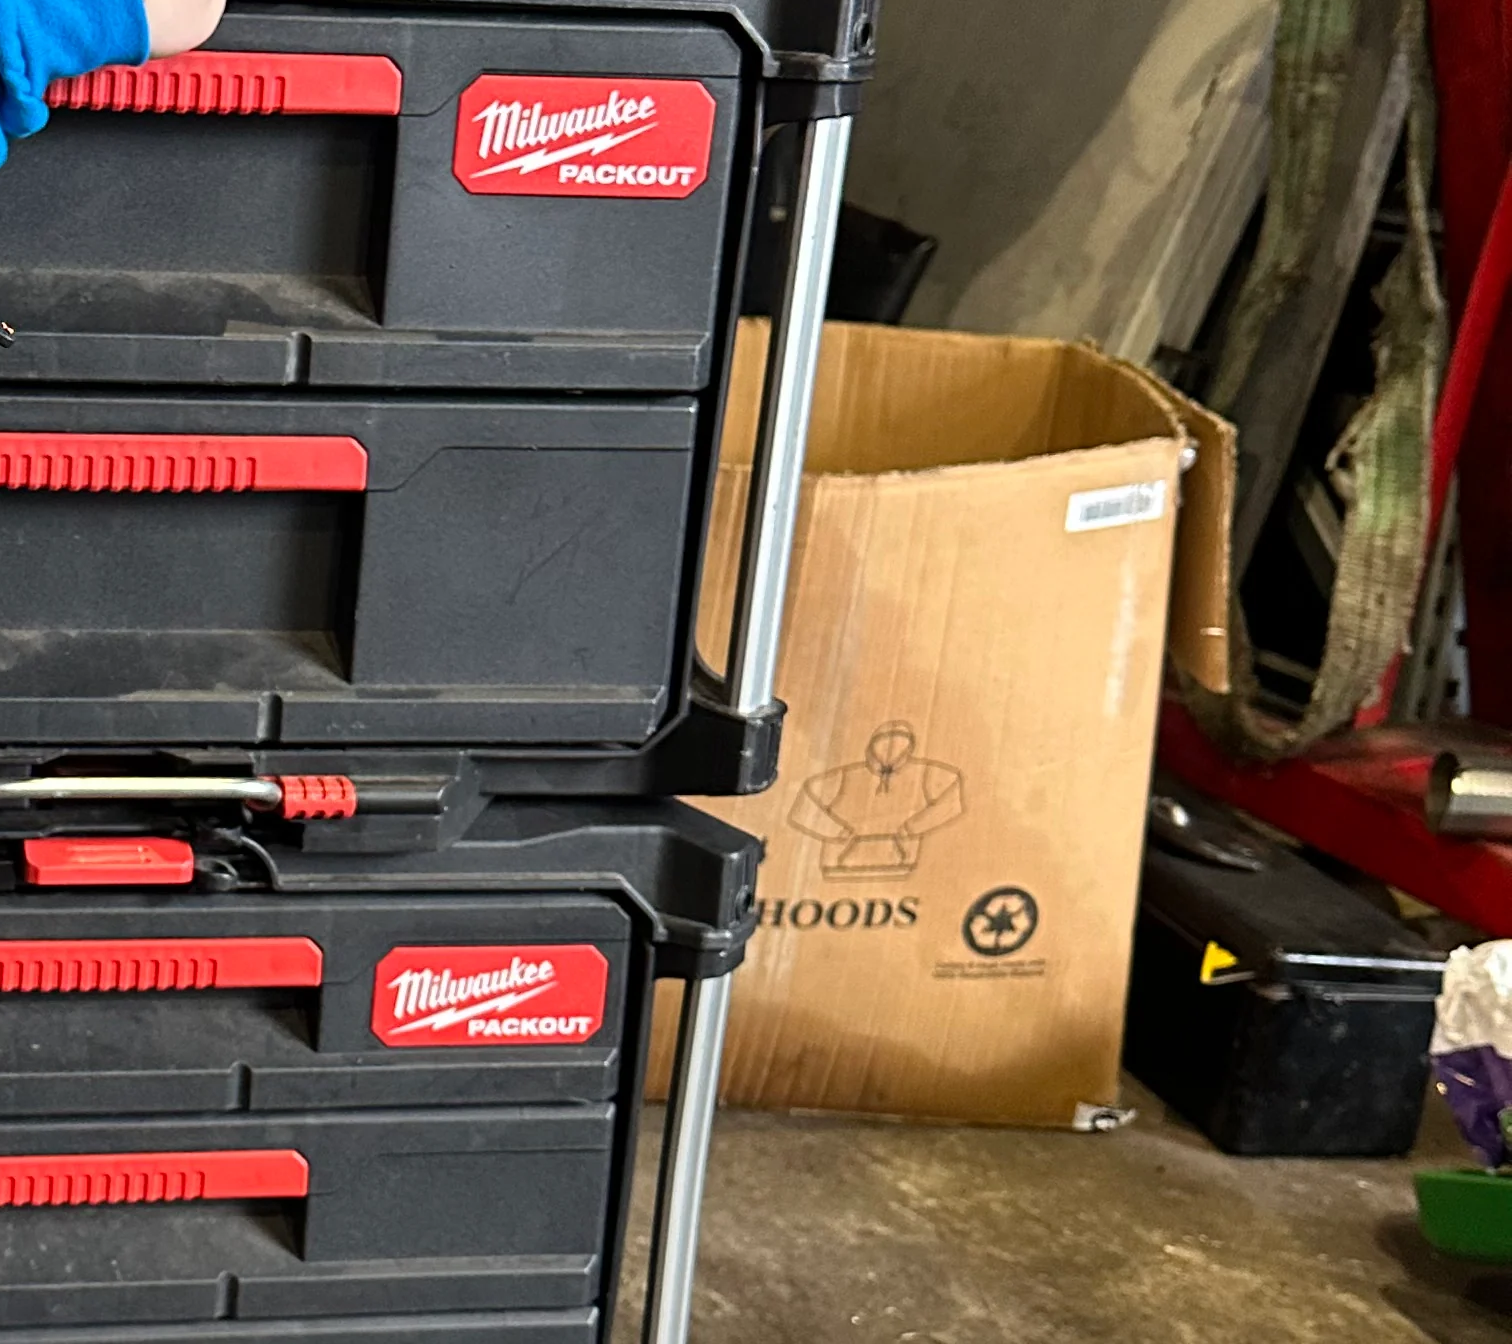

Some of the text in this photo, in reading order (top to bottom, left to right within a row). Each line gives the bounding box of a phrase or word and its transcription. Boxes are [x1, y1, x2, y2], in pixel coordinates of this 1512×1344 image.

[472, 90, 658, 159] Milwaukee
[558, 163, 696, 186] PACKOUT
[757, 896, 920, 931] HOODS
[386, 956, 556, 1020] Milwaukee
[467, 1016, 593, 1037] PACKOUT
